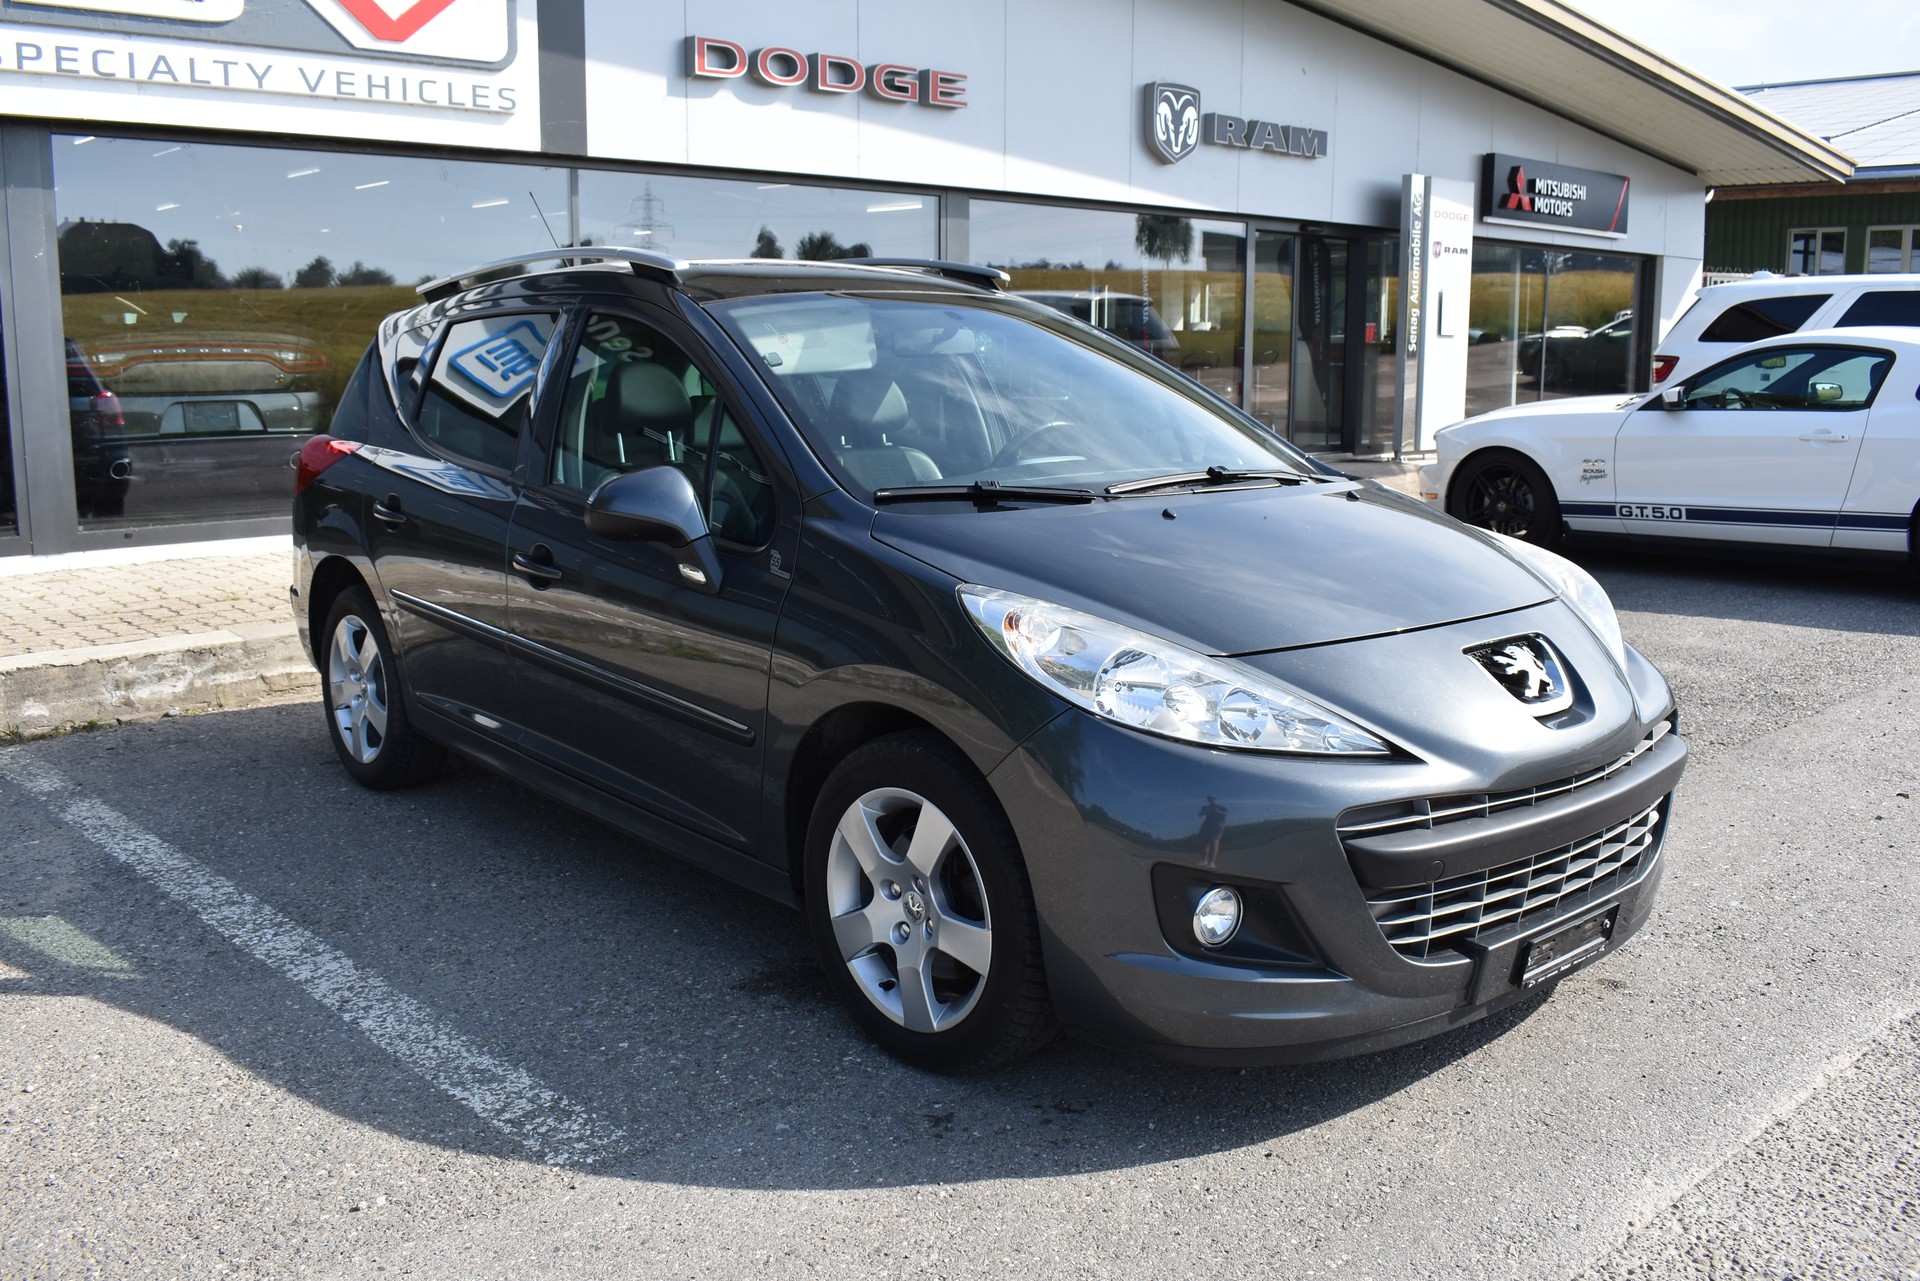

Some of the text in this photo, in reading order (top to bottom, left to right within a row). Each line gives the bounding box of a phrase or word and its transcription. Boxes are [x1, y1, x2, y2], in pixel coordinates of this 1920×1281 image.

[0, 42, 517, 111] PECIALTY VEHICLES
[686, 35, 968, 108] DODGE
[1207, 112, 1328, 158] RAM
[1535, 178, 1587, 201] MITSUBISHI
[1434, 210, 1469, 222] DODGE
[1534, 197, 1573, 217] MOTORS
[1444, 246, 1469, 256] RAM
[1408, 193, 1423, 352] Senag Automobile AG
[1619, 504, 1683, 520] G.T.5.0
